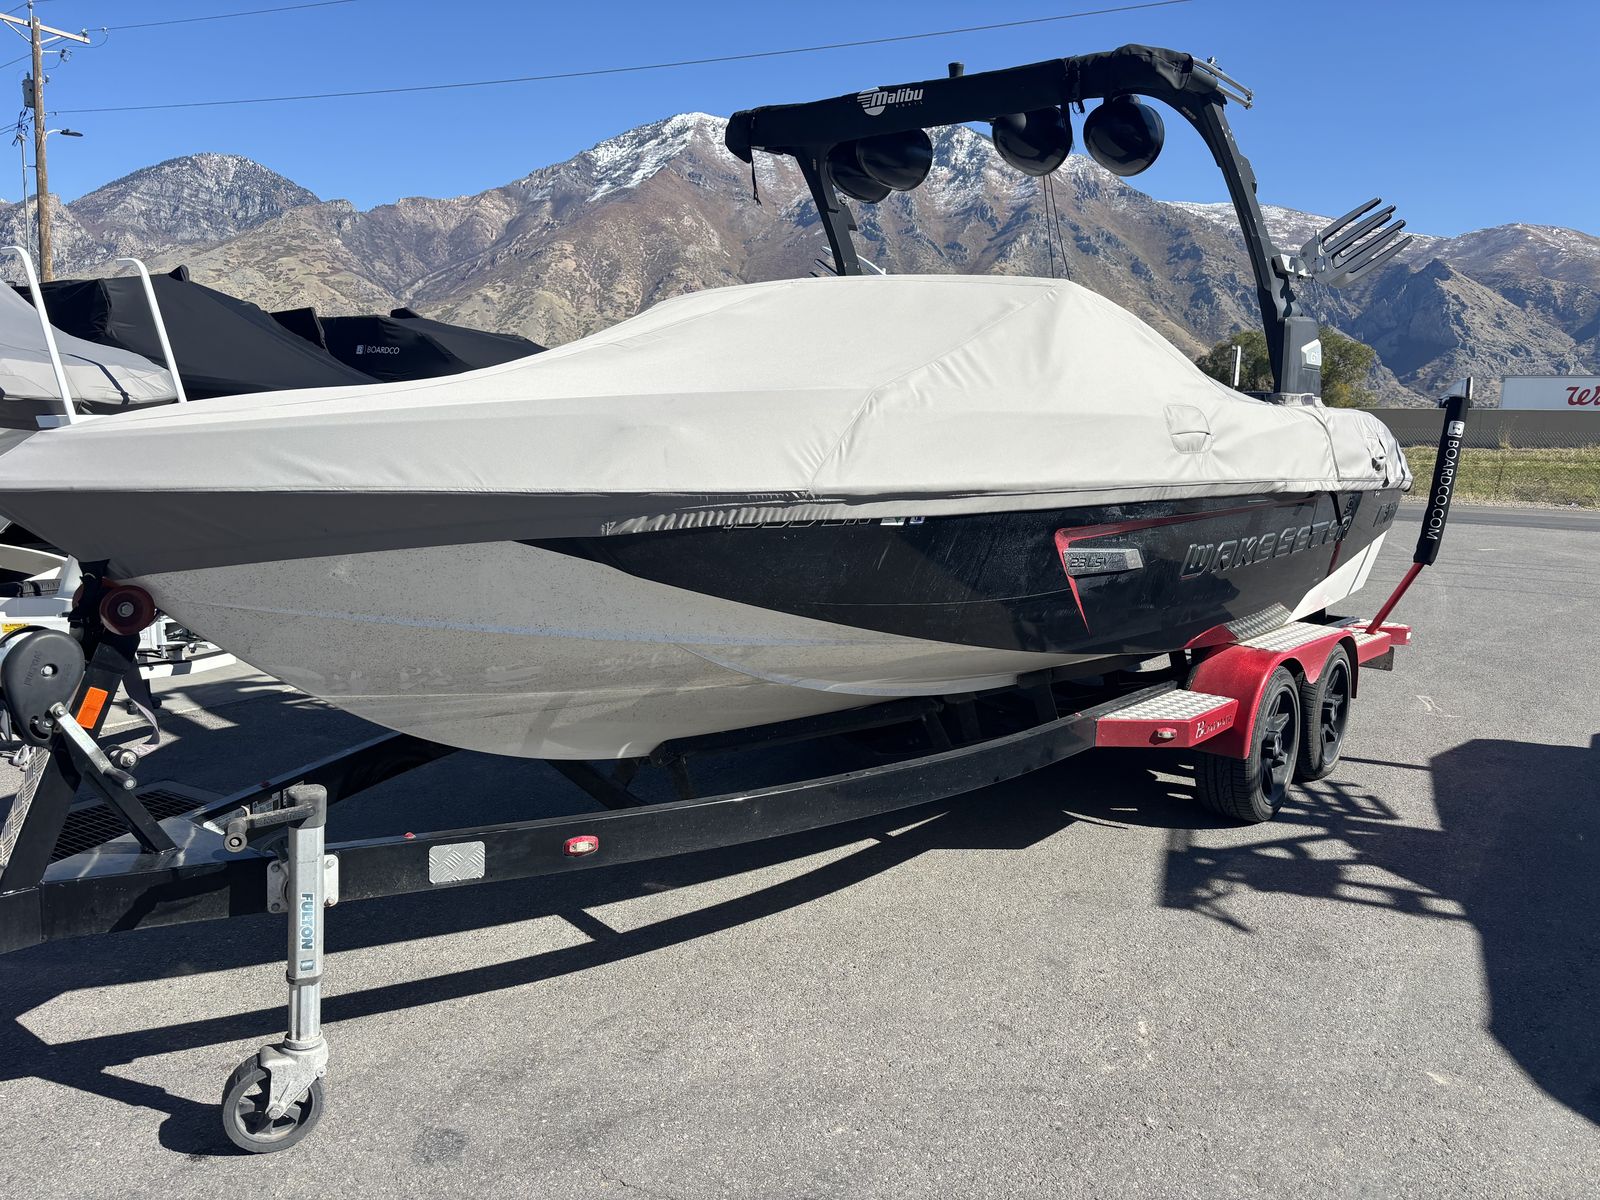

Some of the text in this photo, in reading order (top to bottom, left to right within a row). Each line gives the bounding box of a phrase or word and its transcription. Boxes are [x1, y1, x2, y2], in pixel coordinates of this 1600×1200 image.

[870, 87, 924, 107] Malibu
[367, 345, 400, 355] BOARDCO
[1426, 439, 1460, 540] BOARDCO.COM
[301, 893, 314, 950] FULTON
